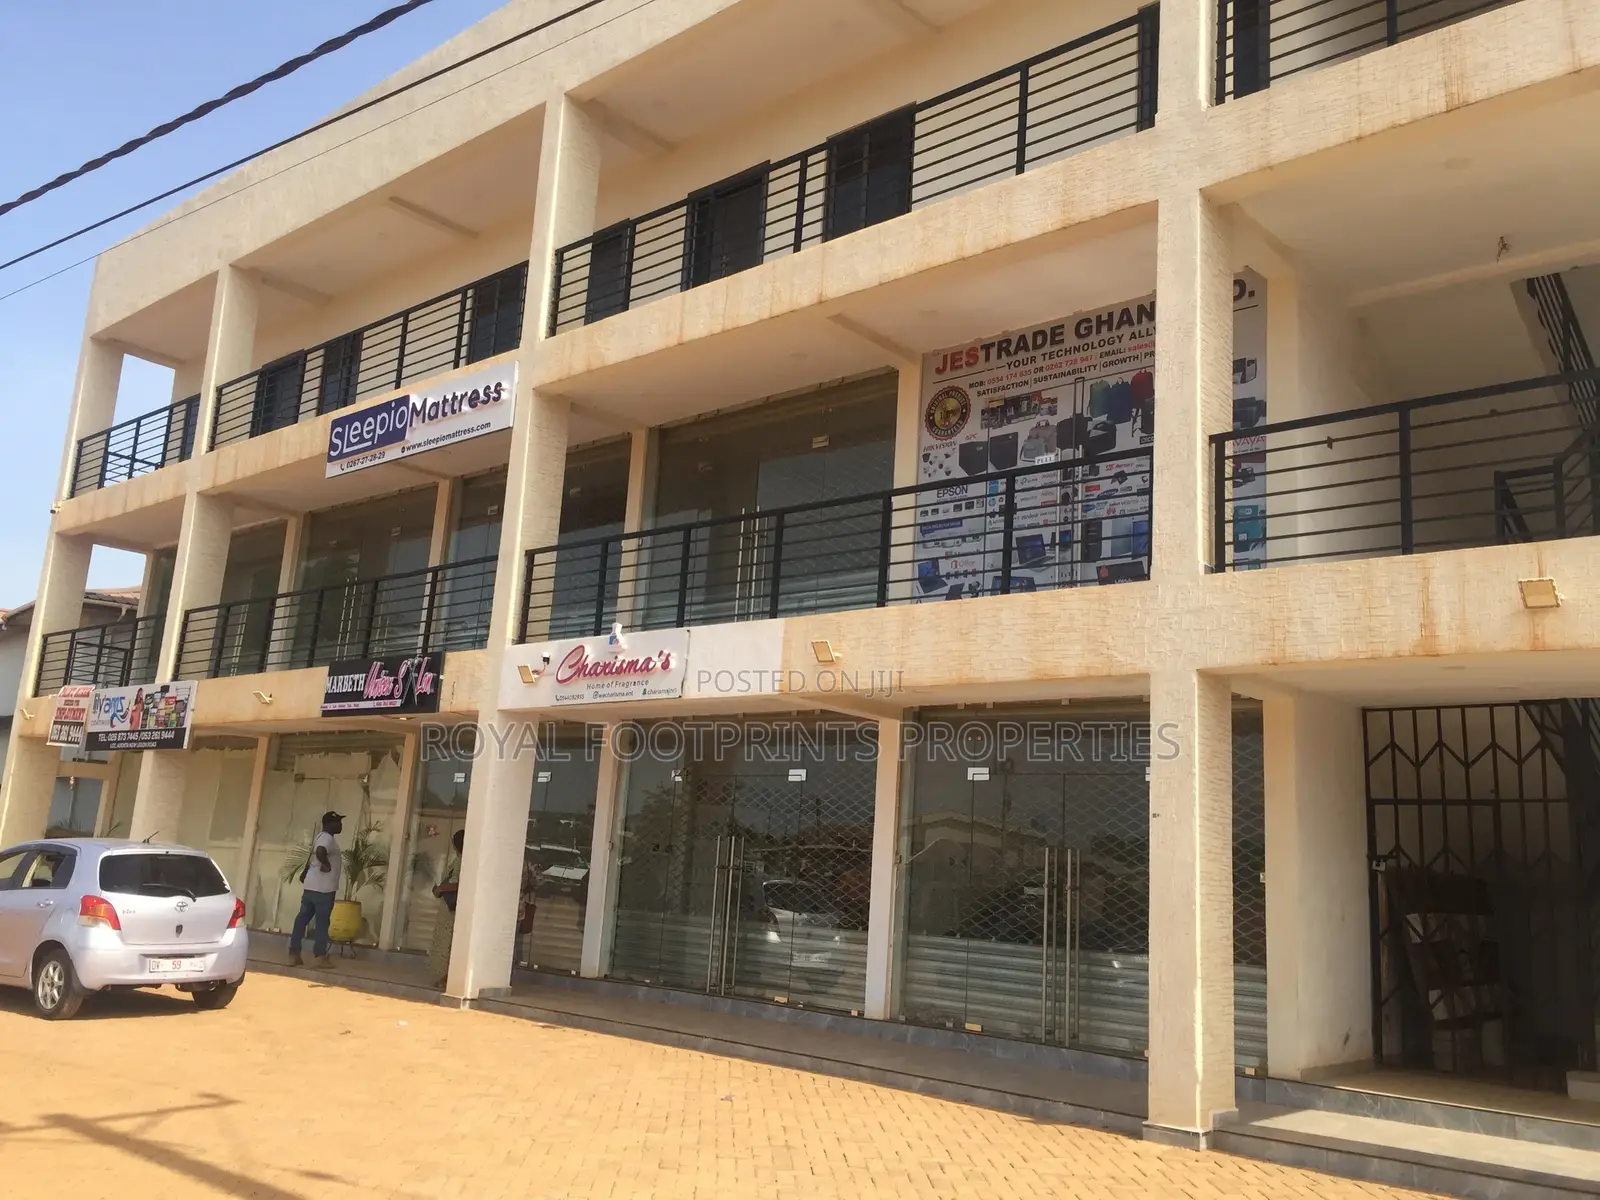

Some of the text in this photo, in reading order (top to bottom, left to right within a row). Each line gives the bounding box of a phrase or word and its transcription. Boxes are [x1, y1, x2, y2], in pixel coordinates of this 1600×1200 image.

[935, 324, 1065, 375] JESTRADE
[969, 381, 986, 390] MOB:
[987, 376, 1004, 385] 0534
[1006, 373, 1017, 381] 174
[1033, 366, 1044, 374] OR
[1045, 361, 1063, 371] 0262
[1065, 358, 1078, 366] 728
[1099, 347, 1126, 359] EMAIL:
[1006, 355, 1037, 370] YOUR
[1041, 333, 1124, 361] TECHNOLOGY
[977, 379, 1029, 397] SATISFACTION
[1033, 364, 1098, 385] SUSTAINABILITY
[1102, 354, 1139, 369] GROWTH
[409, 382, 503, 428] Mattress
[406, 422, 491, 451] www.sleepiomattress.com
[936, 485, 969, 499] EPSON
[326, 673, 366, 694] MARBETH
[556, 645, 671, 684] Charisma's
[614, 680, 649, 689] Fragrance
